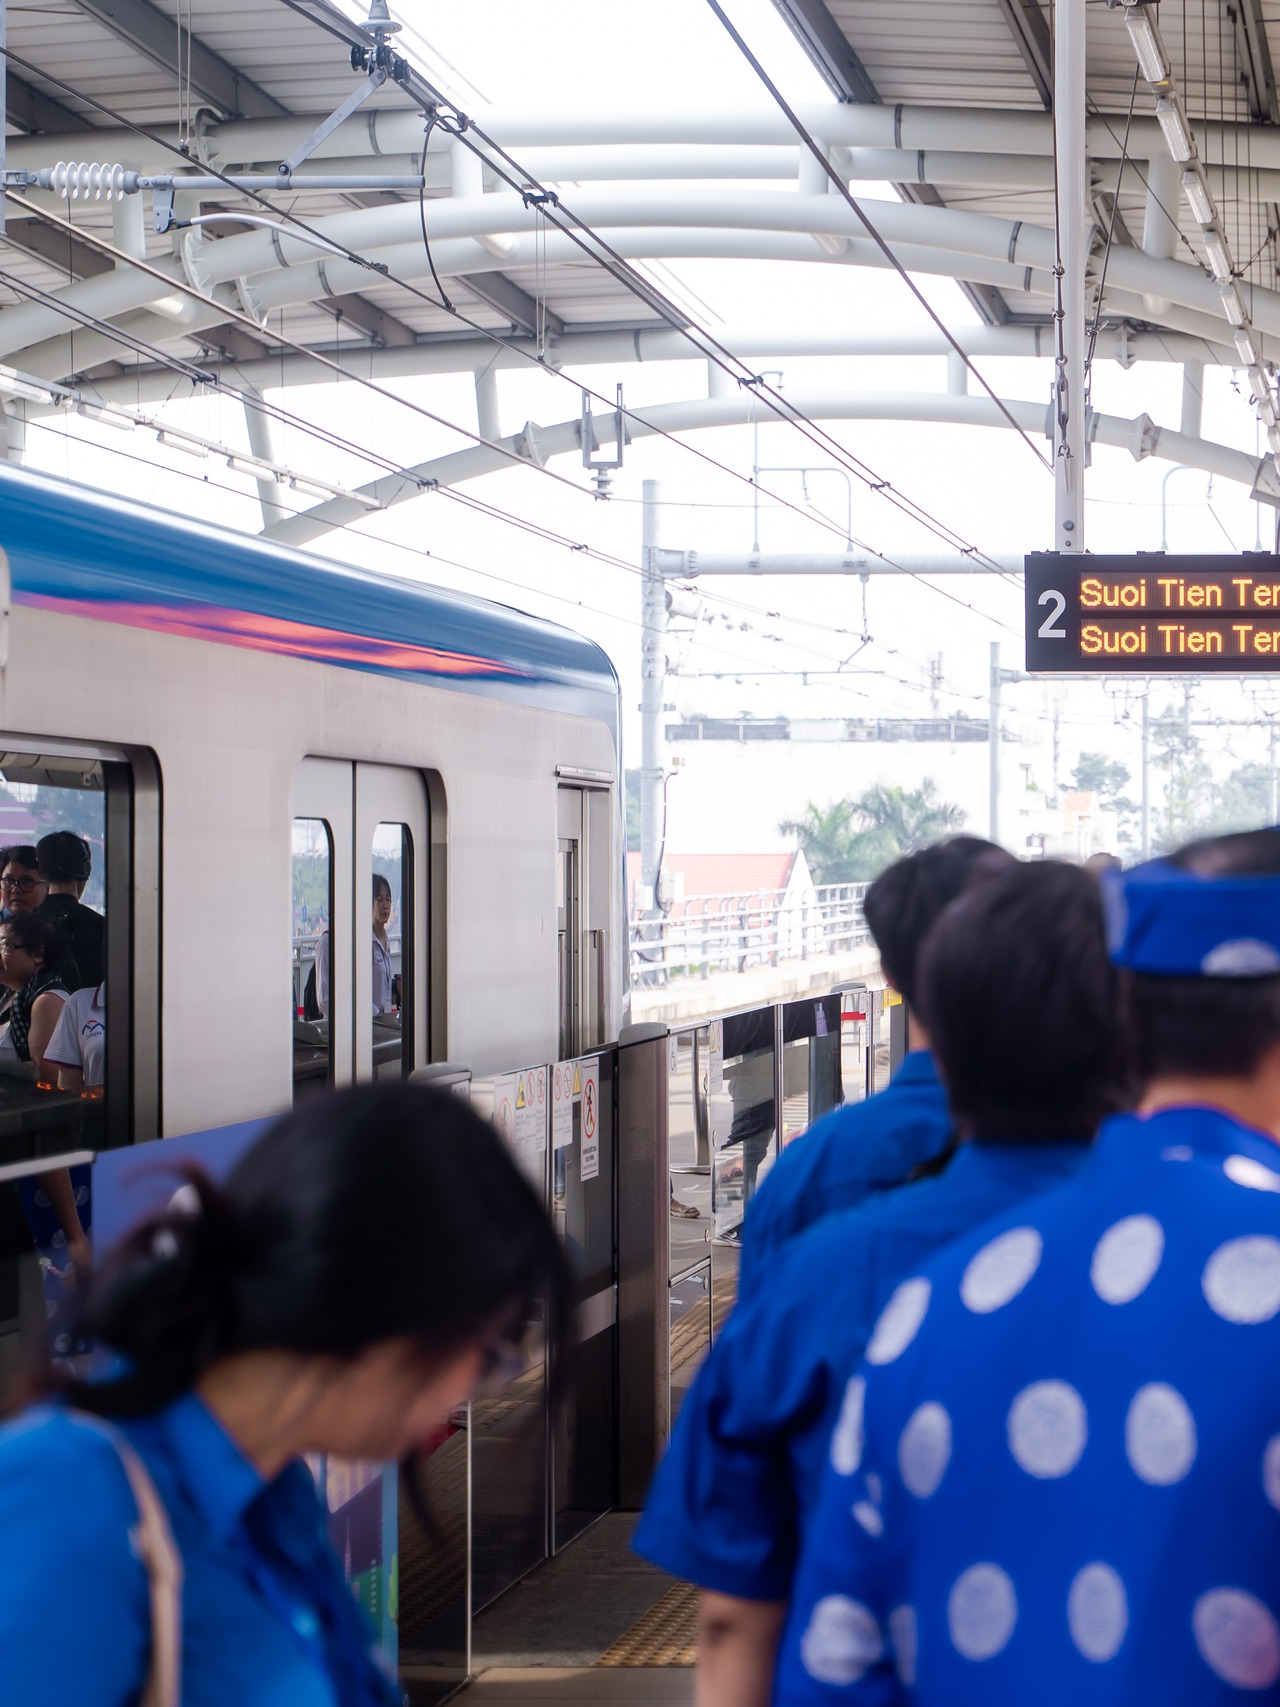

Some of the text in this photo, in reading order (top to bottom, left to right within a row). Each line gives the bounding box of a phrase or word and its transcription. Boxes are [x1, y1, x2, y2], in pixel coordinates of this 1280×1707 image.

[1080, 578, 1146, 607] Suoi
[1157, 578, 1222, 607] Tien
[1038, 589, 1066, 638] 2
[1080, 625, 1147, 653] Suoi
[1157, 625, 1222, 653] Tien
